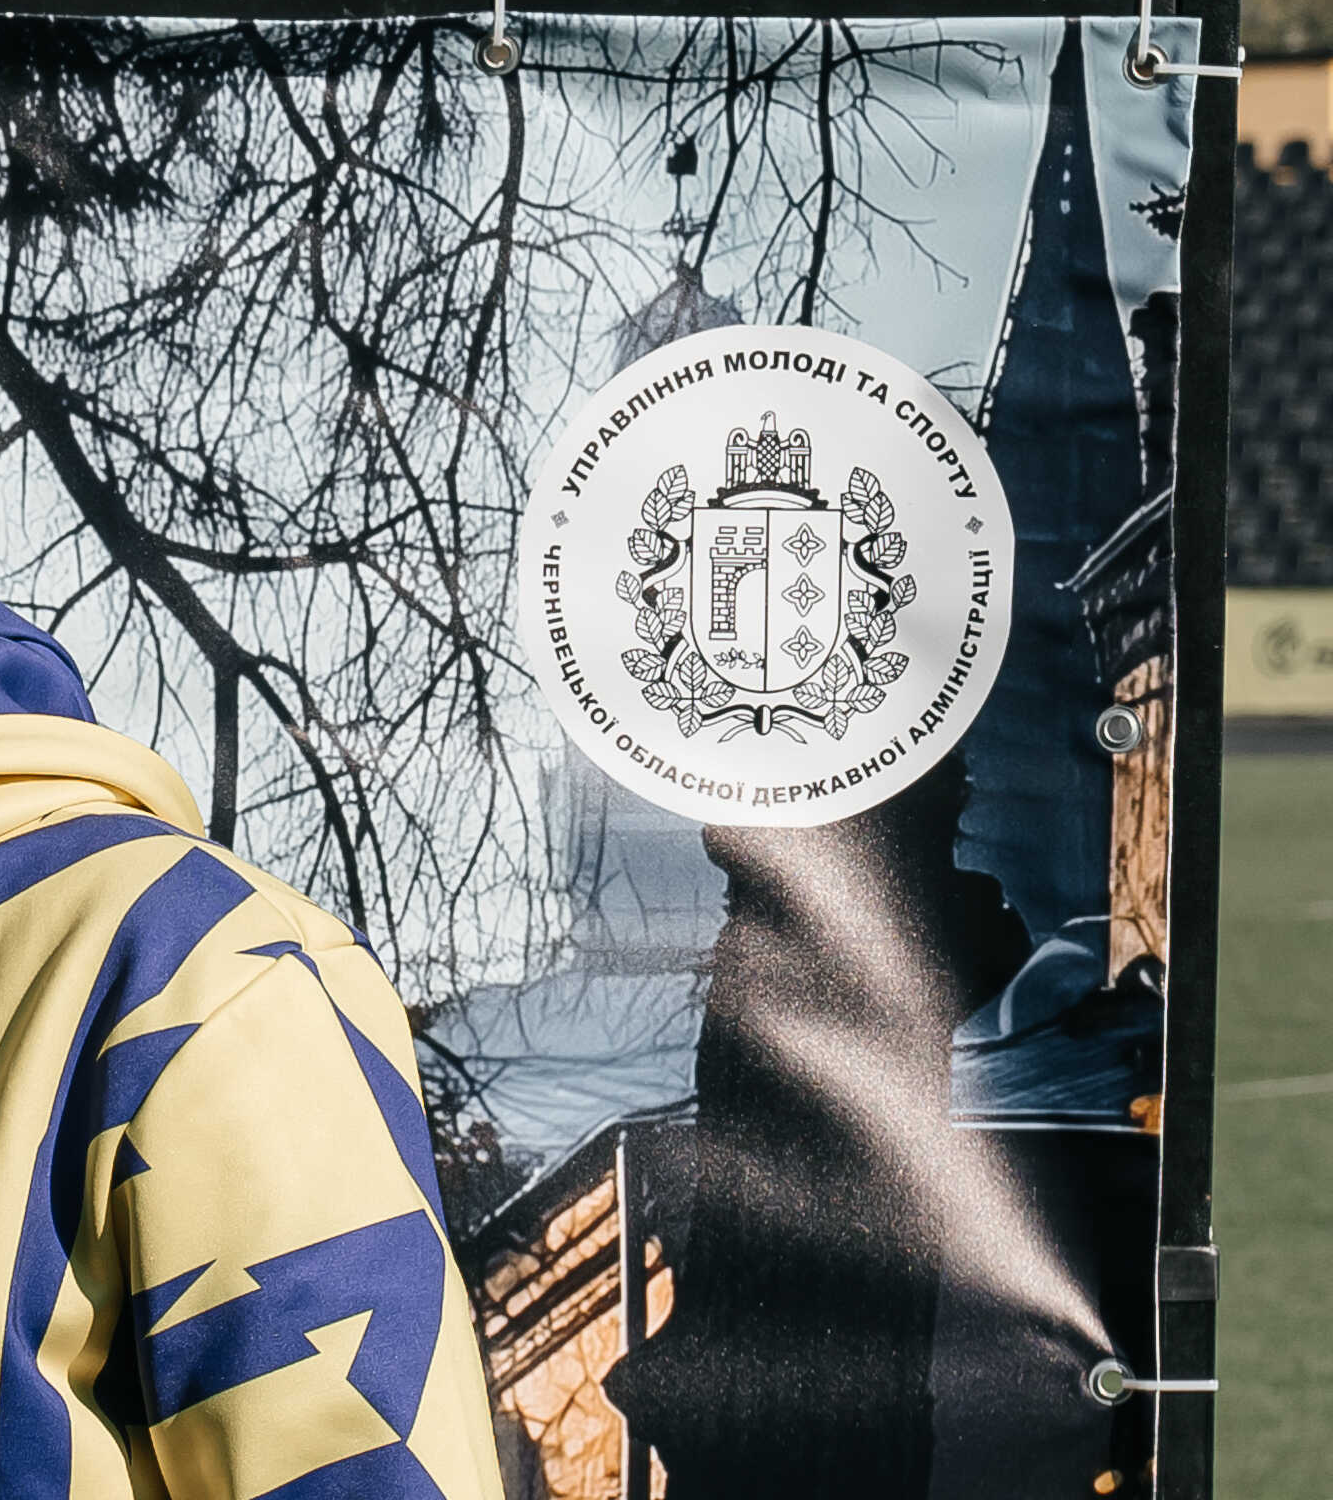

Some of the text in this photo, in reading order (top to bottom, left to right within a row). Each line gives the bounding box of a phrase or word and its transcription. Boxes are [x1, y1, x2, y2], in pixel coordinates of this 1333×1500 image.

[561, 349, 979, 501] УПРАВЛІННЯ МОЛОДІ ТА СПОРТУ
[542, 542, 992, 808] ЧЕРНІВЕЦЬКОЇ ОБЛАСНОЇ ДЕРЖАВНОЇ АДМІНІСТРАЦІЇ
